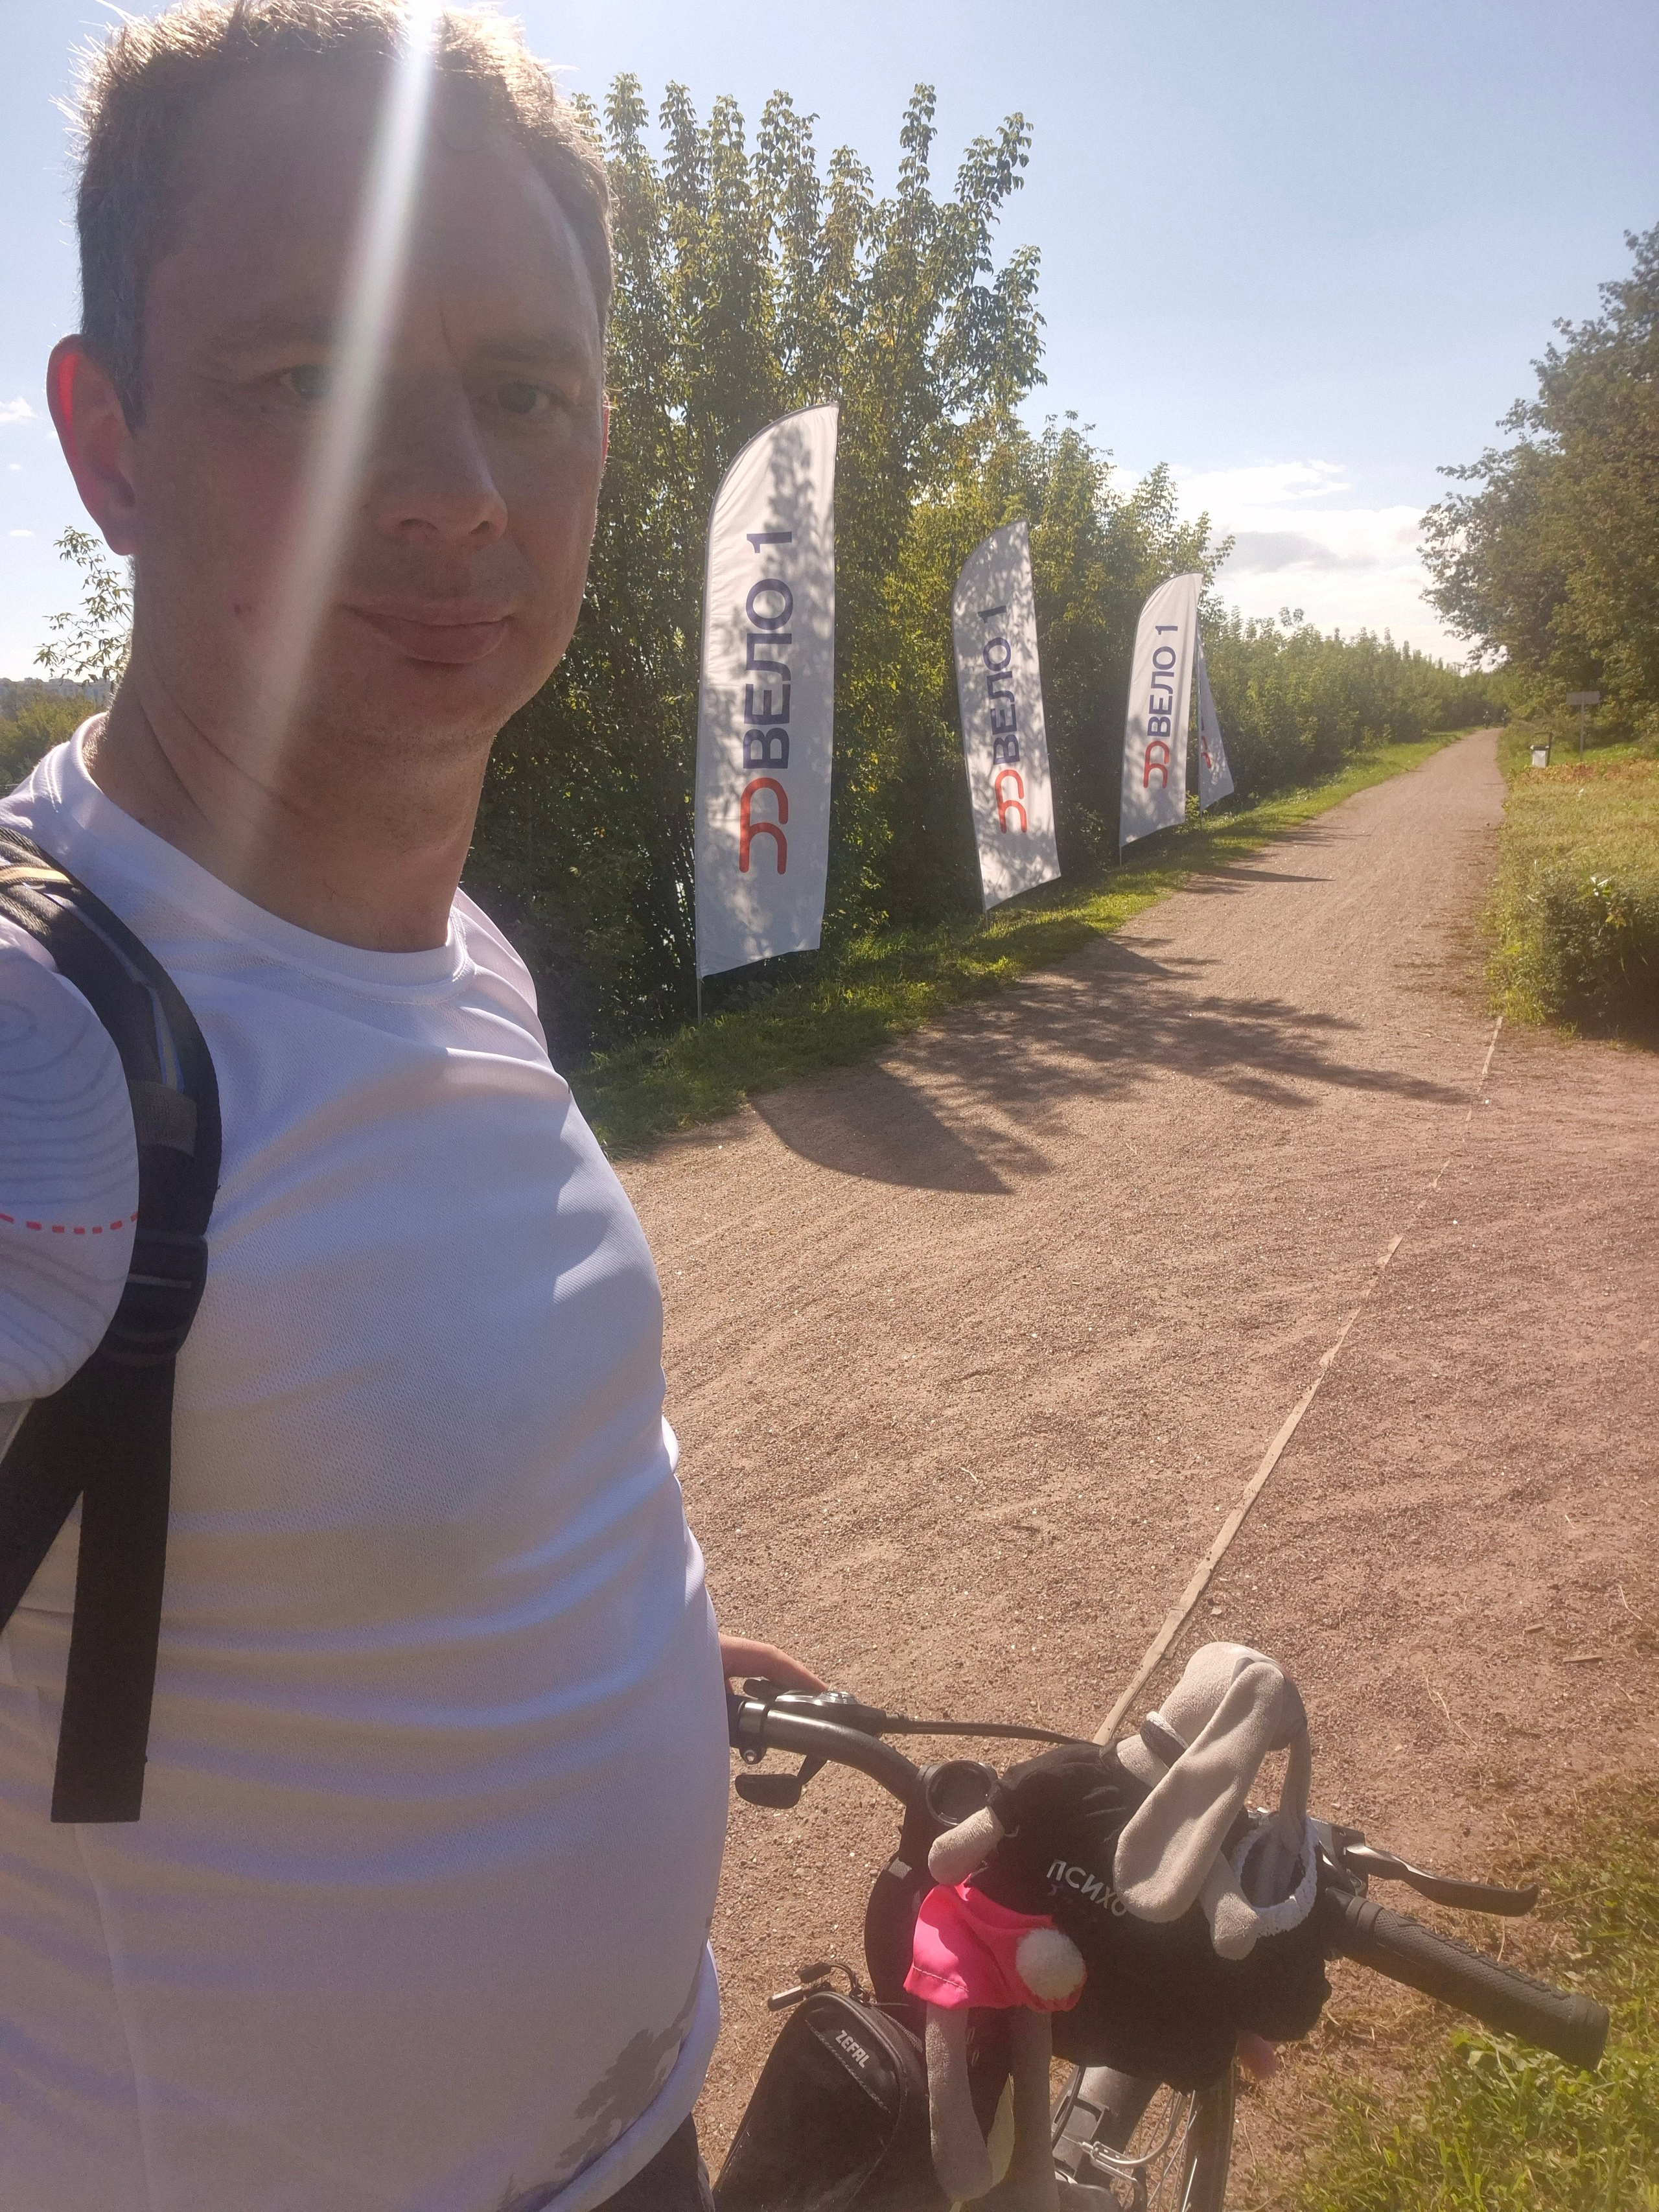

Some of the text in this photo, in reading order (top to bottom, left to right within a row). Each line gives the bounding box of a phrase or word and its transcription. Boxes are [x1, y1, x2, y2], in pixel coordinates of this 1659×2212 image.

[743, 531, 793, 769] ВЕЛО 1
[978, 605, 1020, 765] ВЕЛО 1
[1147, 625, 1178, 737] ВЕЛО 1
[835, 2030, 870, 2068] ZEFAL
